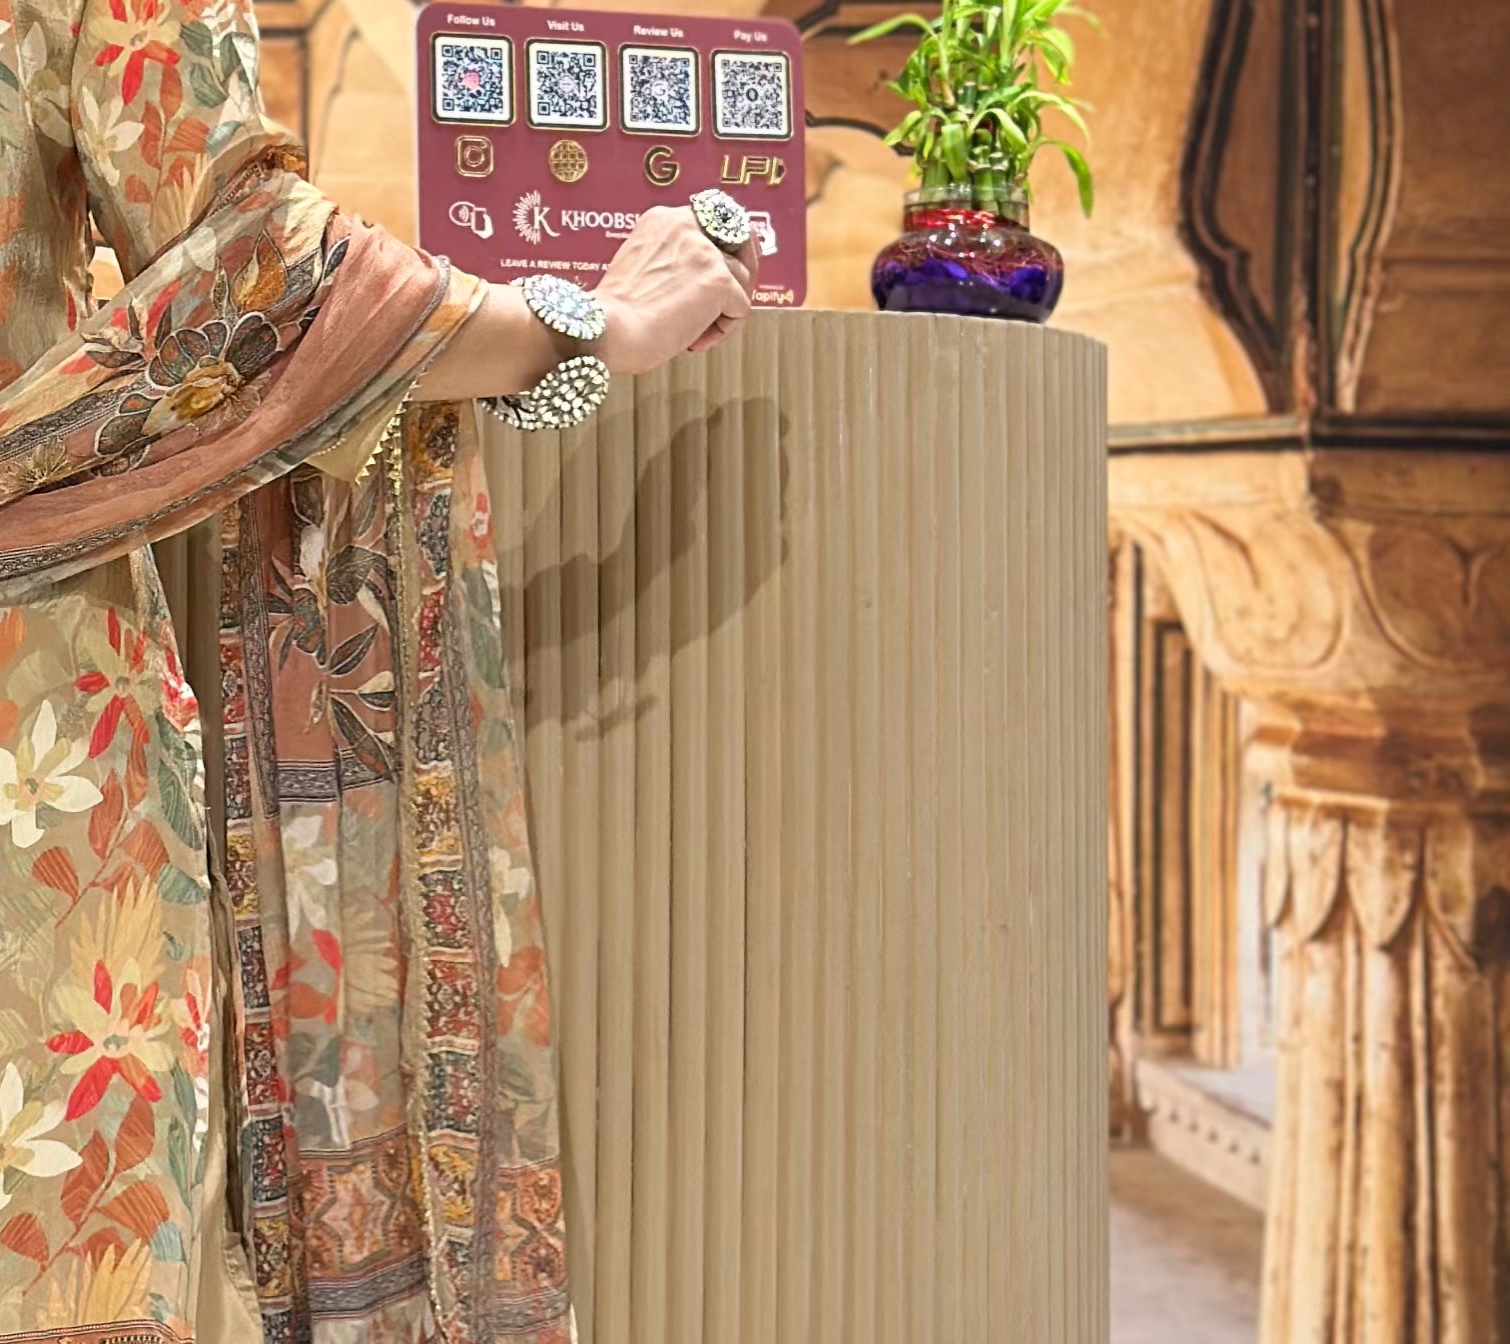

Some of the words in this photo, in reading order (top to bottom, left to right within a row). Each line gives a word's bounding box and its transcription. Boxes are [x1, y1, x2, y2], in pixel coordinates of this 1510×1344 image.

[447, 14, 480, 26] Follow
[482, 16, 496, 27] Us
[547, 20, 570, 31] Visit
[571, 22, 585, 32] Us
[633, 25, 668, 37] Review
[670, 28, 684, 38] Us
[734, 30, 751, 43] Pay
[754, 32, 768, 42] Us
[643, 144, 681, 186] G
[720, 155, 779, 185] UPI
[533, 206, 560, 237] K
[500, 258, 528, 268] LEAVE
[537, 260, 571, 270] REVIEW
[572, 261, 600, 271] TODAY
